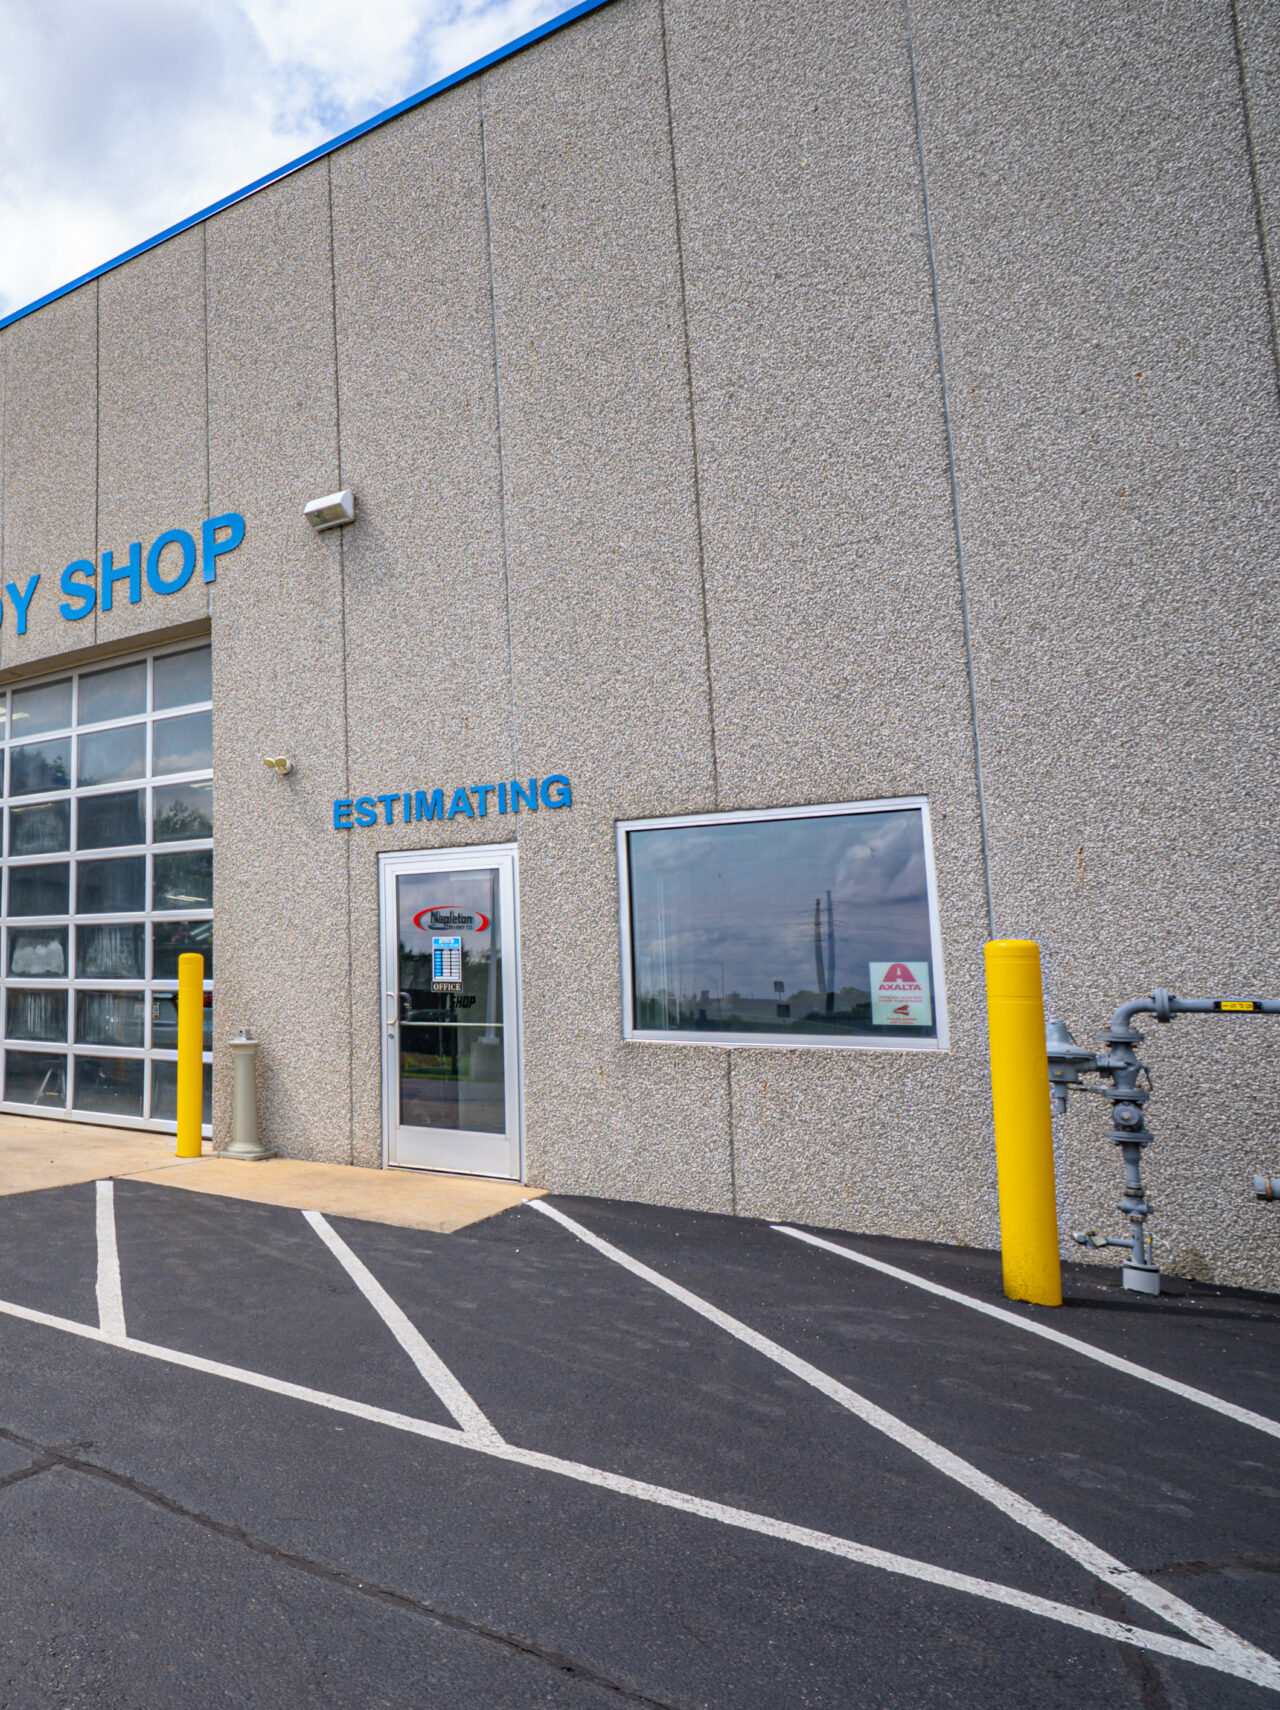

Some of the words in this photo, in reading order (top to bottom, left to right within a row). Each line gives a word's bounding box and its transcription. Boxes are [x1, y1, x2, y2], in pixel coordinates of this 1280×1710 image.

[59, 512, 246, 621] SHOP
[333, 774, 572, 830] ESTIMATING
[430, 911, 474, 927] Napleton
[433, 983, 461, 991] OFFICE
